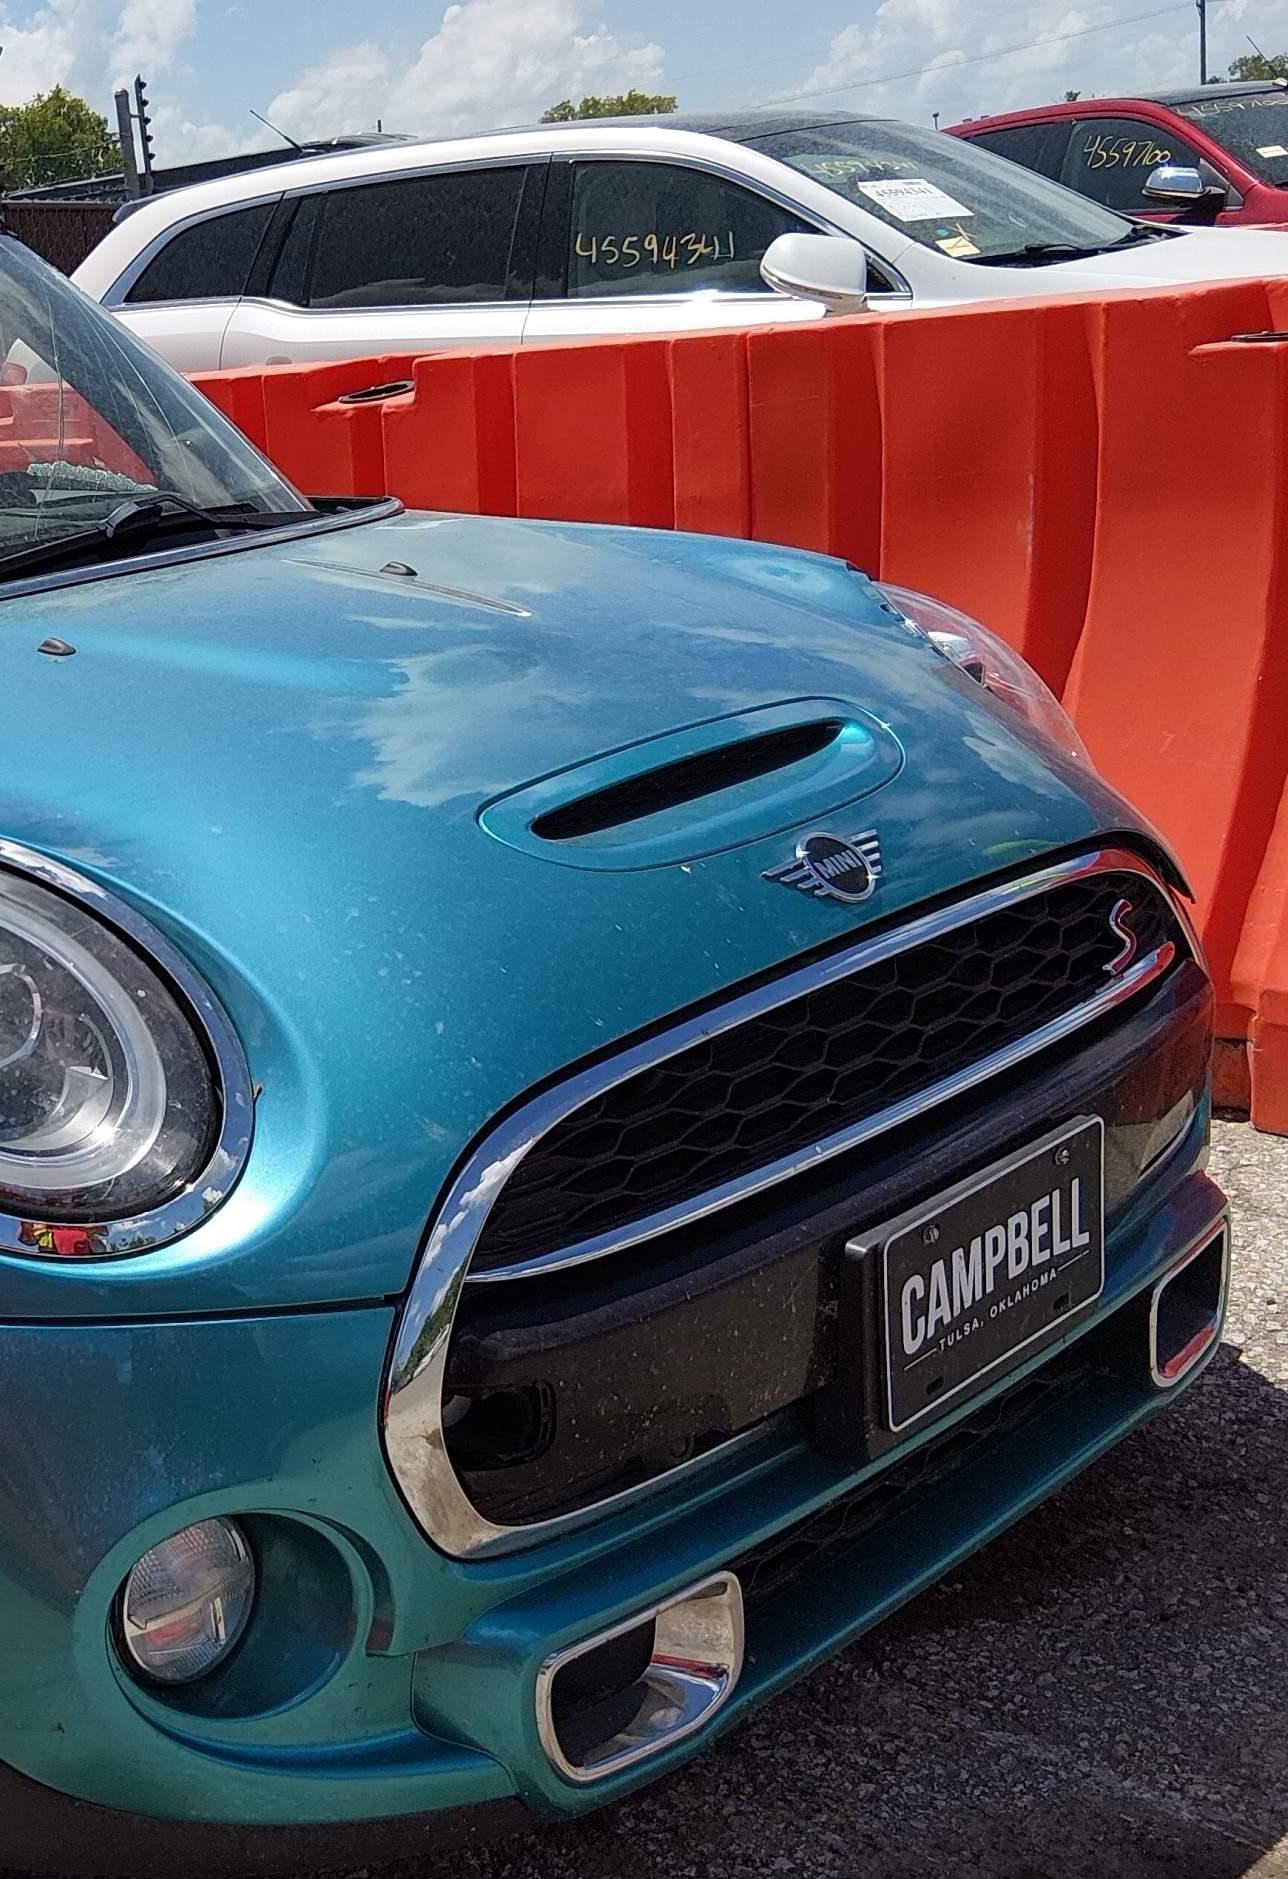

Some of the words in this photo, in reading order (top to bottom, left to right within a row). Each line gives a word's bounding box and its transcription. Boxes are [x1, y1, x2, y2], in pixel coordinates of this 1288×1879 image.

[575, 230, 735, 269] 45594341
[814, 849, 861, 880] MINI
[1102, 899, 1137, 974] S
[901, 1176, 1090, 1355] CAMPBELL
[939, 1317, 984, 1351] TULSA,
[989, 1267, 1057, 1319] OKLAHOMA
